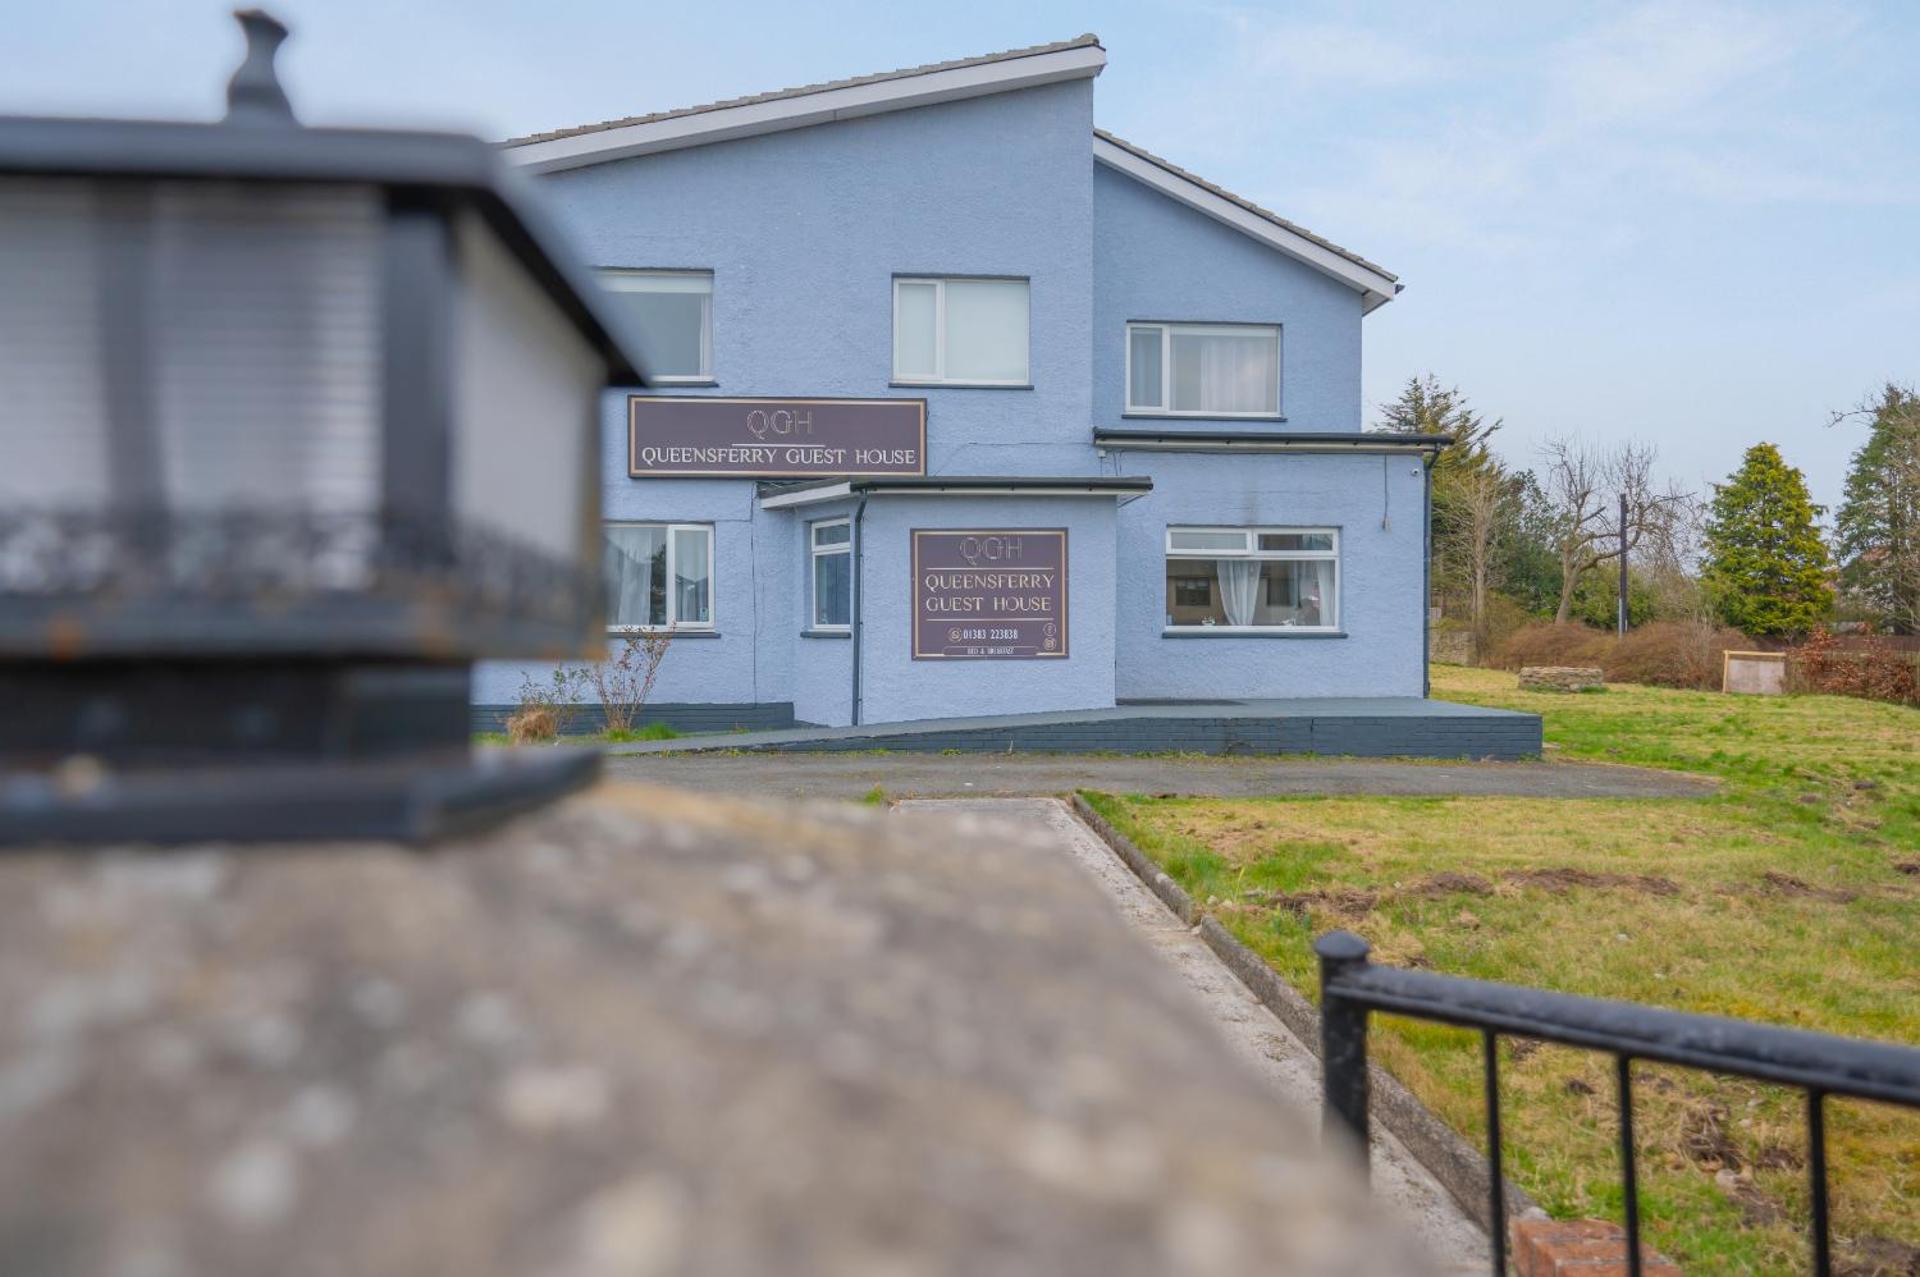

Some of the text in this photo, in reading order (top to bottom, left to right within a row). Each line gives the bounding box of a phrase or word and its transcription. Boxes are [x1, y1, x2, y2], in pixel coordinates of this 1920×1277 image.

[746, 409, 813, 439] QGH
[641, 447, 916, 466] QUEENSFERRY GUEST HOUSE
[960, 536, 1022, 566] QGH
[925, 574, 1054, 592] QUEENSFERRY
[926, 597, 1052, 612] GUEST HOUSE
[963, 628, 1018, 639] 01383 223838
